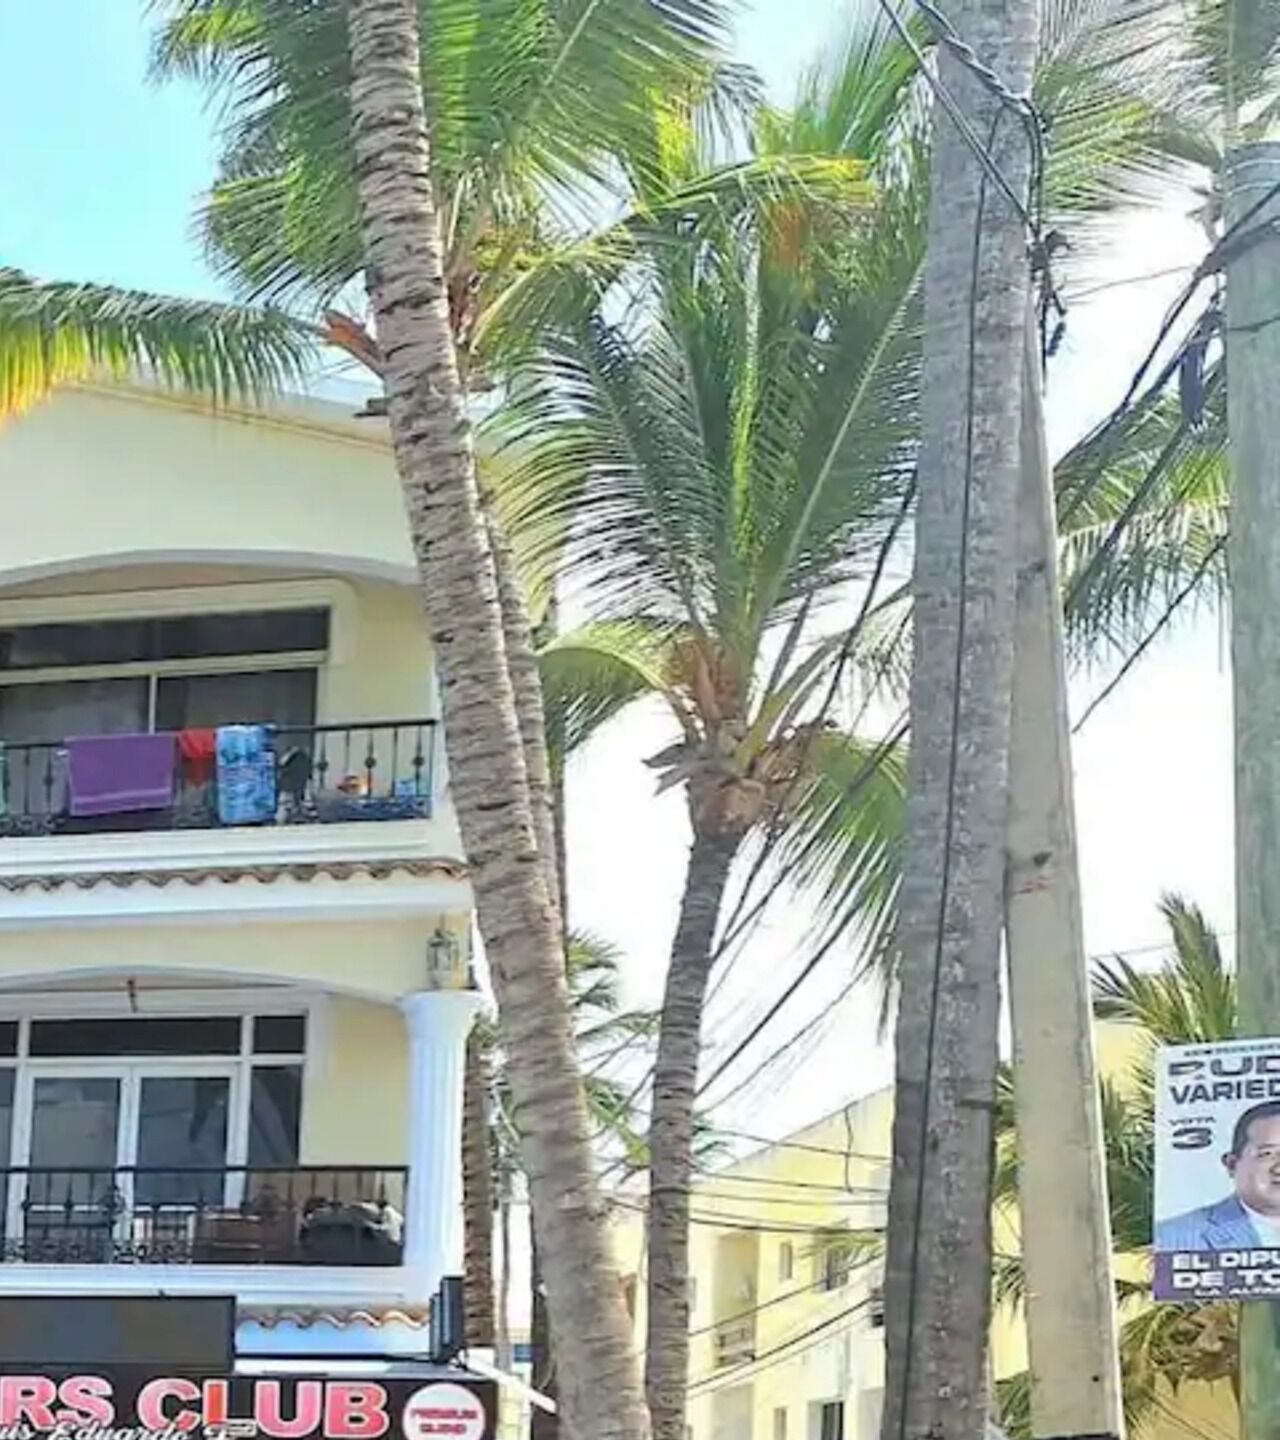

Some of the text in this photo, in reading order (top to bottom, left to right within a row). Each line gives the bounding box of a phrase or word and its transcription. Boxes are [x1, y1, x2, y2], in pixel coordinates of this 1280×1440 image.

[1168, 1117, 1216, 1126] VOTA
[1172, 1127, 1212, 1150] 3
[1173, 1253, 1210, 1269] EL
[1173, 1271, 1224, 1288] DE
[137, 1377, 390, 1439] CLUB
